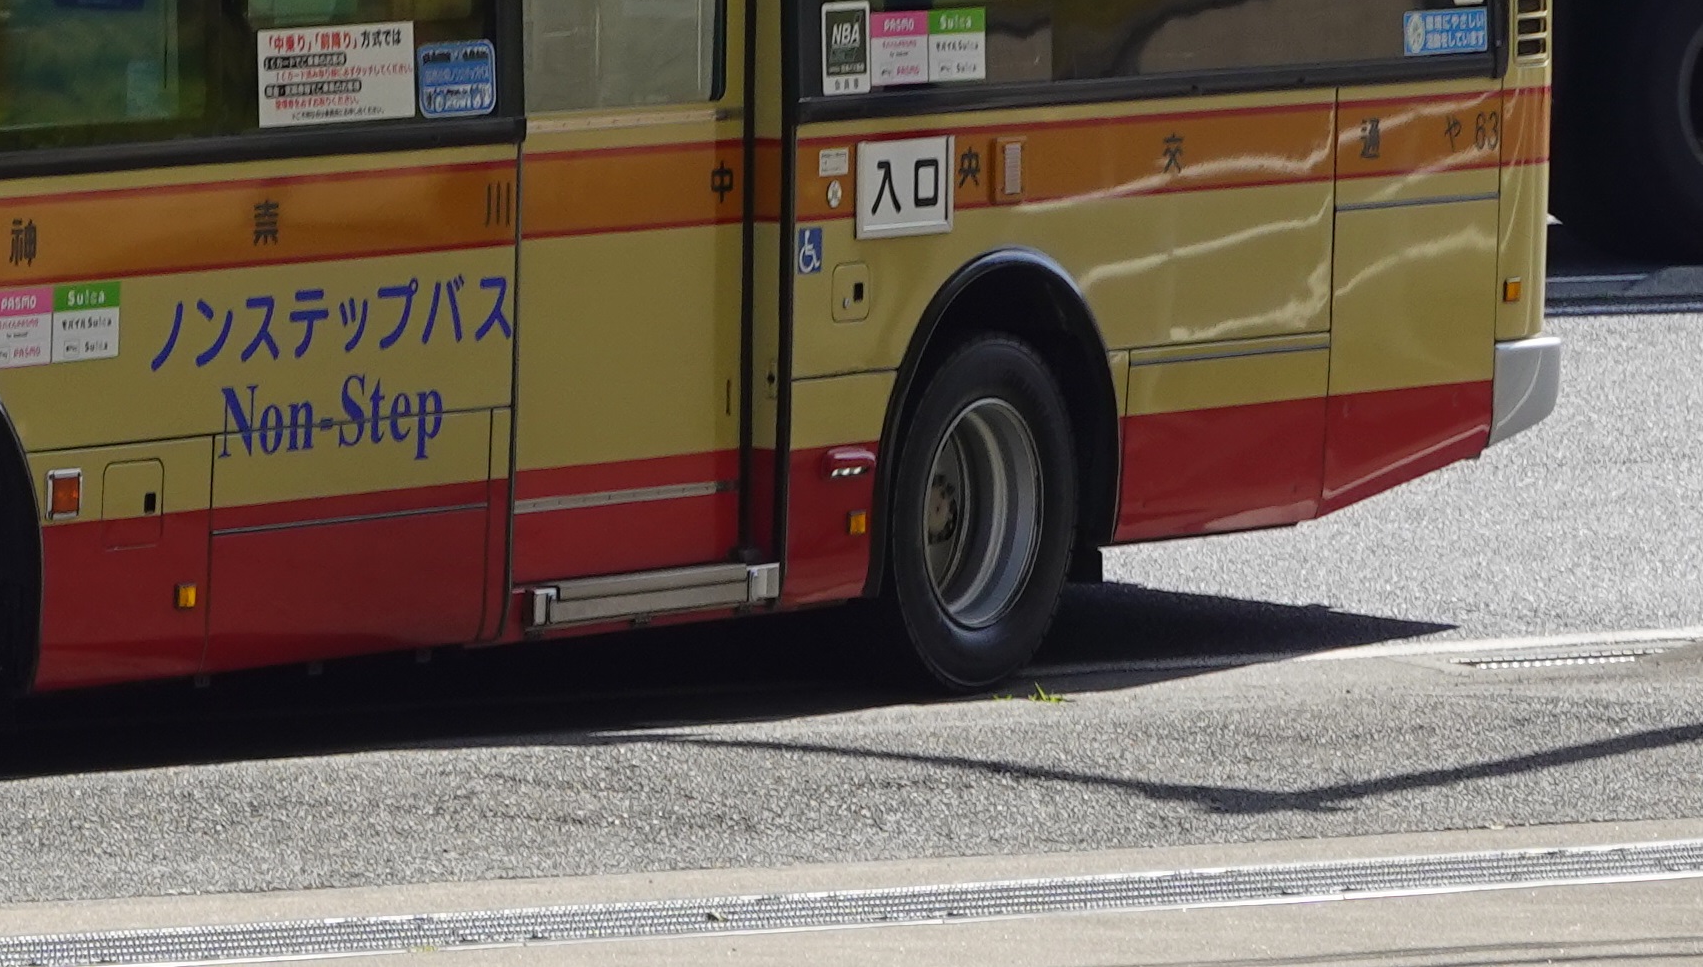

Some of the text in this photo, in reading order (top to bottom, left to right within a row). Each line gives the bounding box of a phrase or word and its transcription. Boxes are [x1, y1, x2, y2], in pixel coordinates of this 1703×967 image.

[883, 17, 915, 32] PASMO
[939, 14, 972, 30] Suica
[831, 22, 861, 47] NBA
[871, 158, 939, 216] 入口
[0, 295, 38, 312] PASMO
[67, 289, 106, 307] Suica
[150, 274, 513, 372] ノンステップバス
[218, 372, 445, 462] Non-Step
